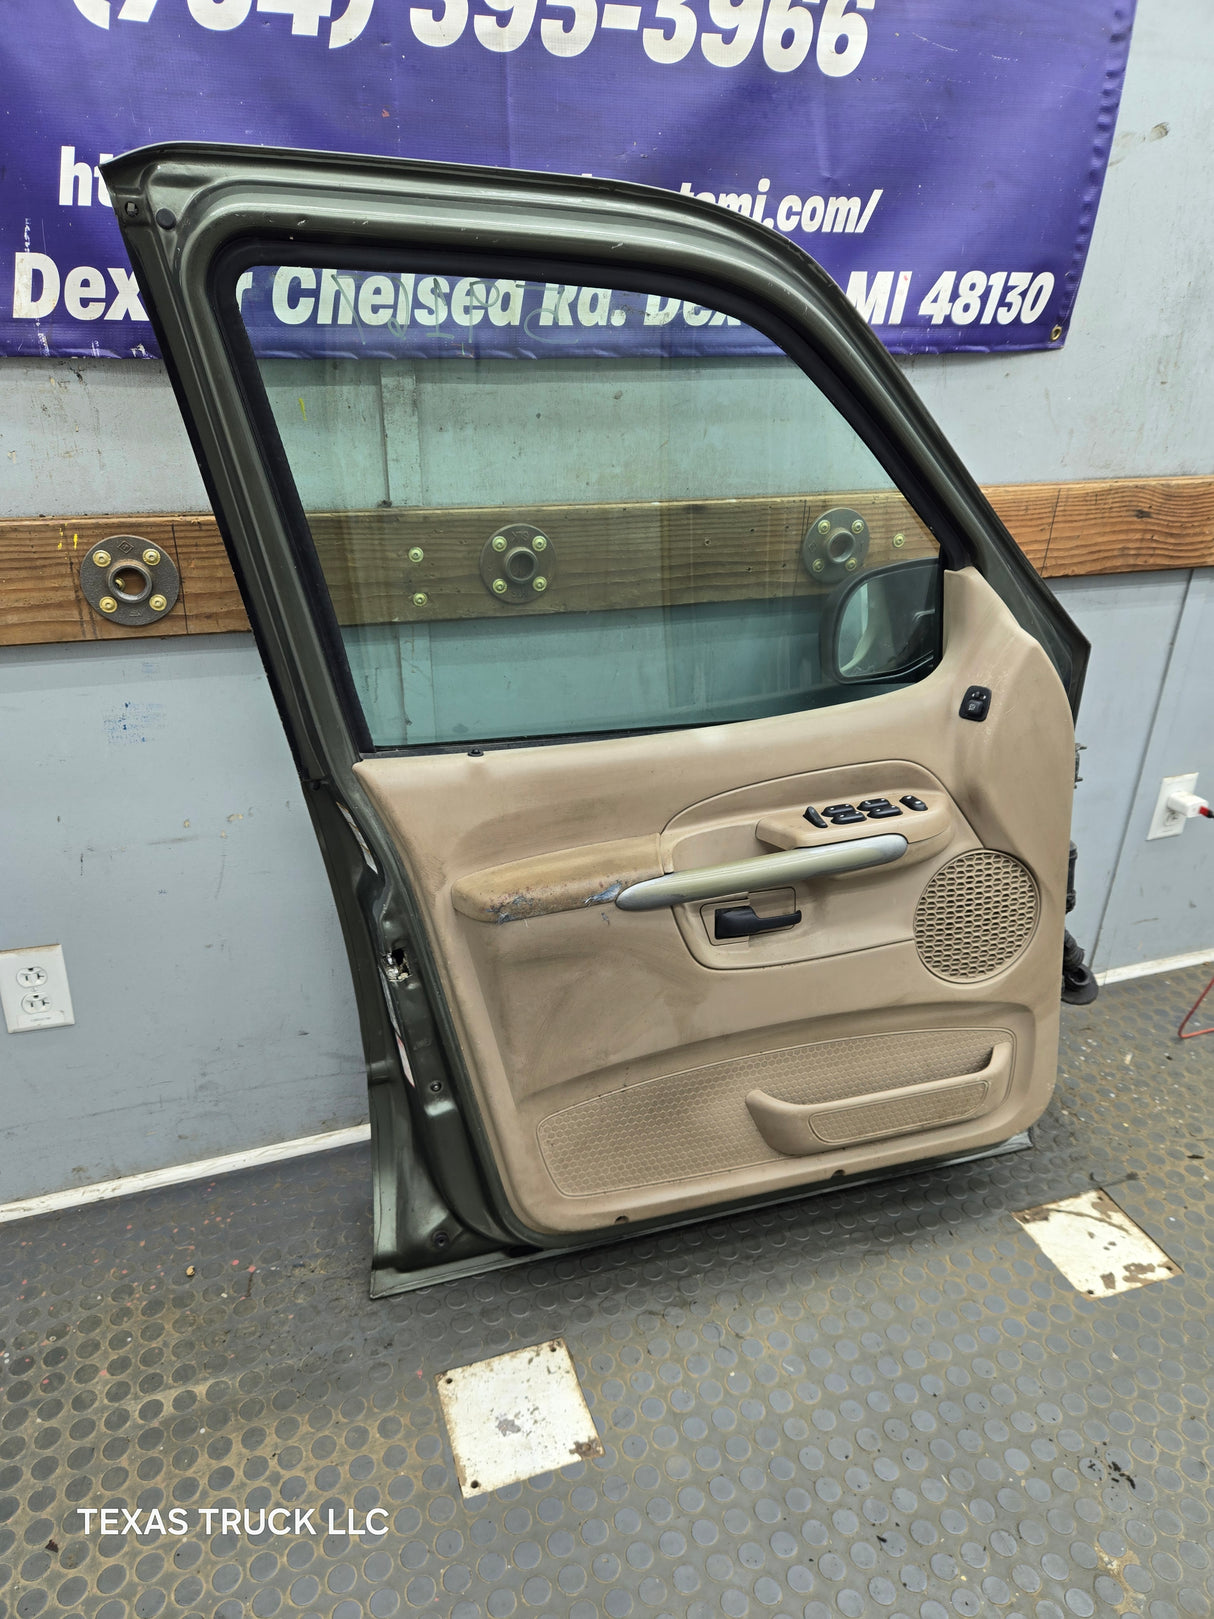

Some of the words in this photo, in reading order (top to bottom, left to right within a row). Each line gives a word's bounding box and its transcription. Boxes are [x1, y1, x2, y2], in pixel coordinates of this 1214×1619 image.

[272, 266, 526, 326] Chelsea
[845, 271, 912, 324] MI
[919, 271, 1055, 324] 48130
